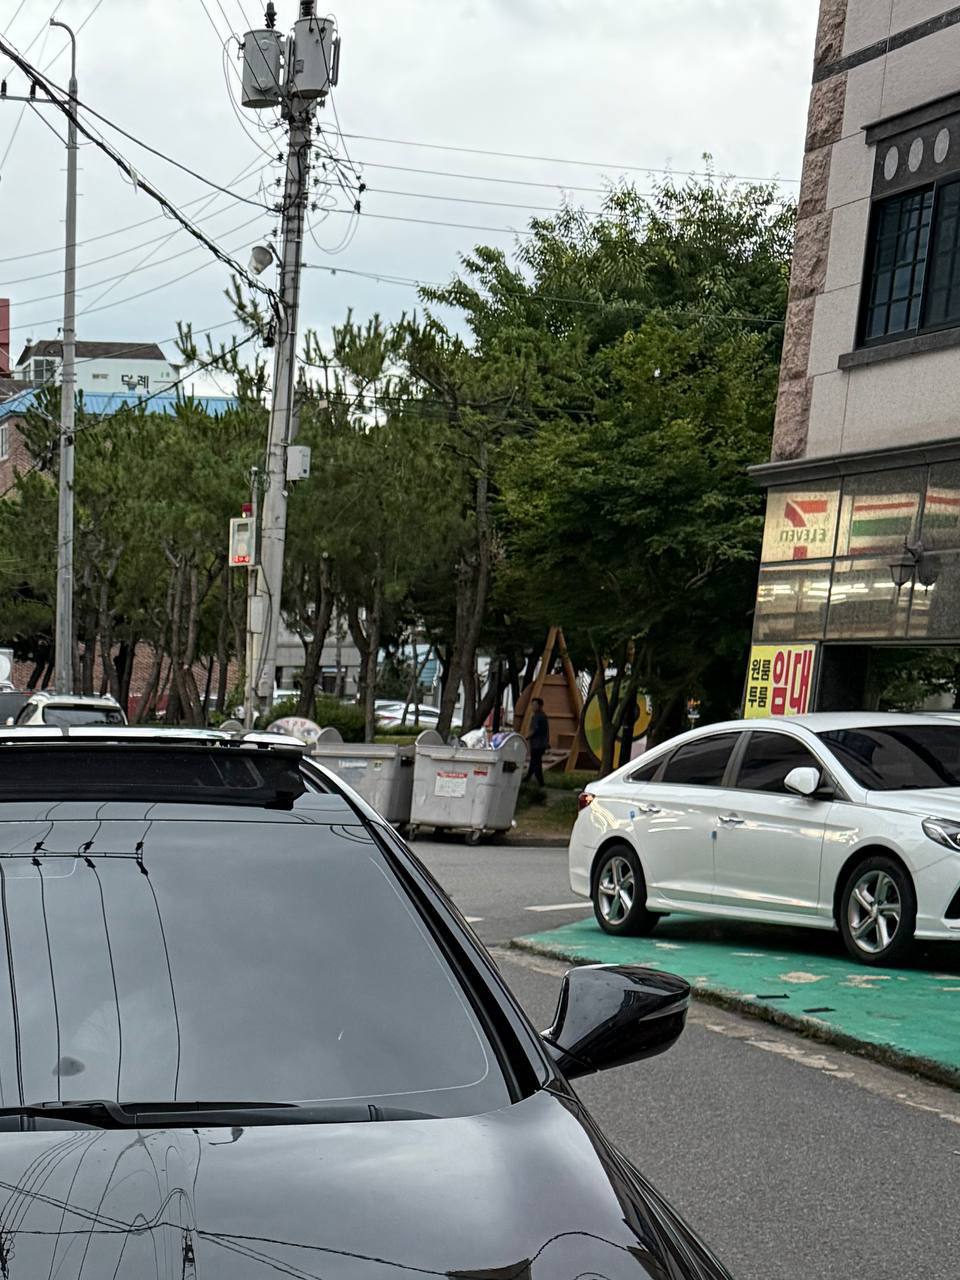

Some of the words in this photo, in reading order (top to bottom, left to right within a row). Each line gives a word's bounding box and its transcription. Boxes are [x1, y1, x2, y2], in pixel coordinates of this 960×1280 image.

[751, 658, 771, 681] 원룸
[771, 649, 813, 715] 임대
[748, 686, 768, 708] 투룸
